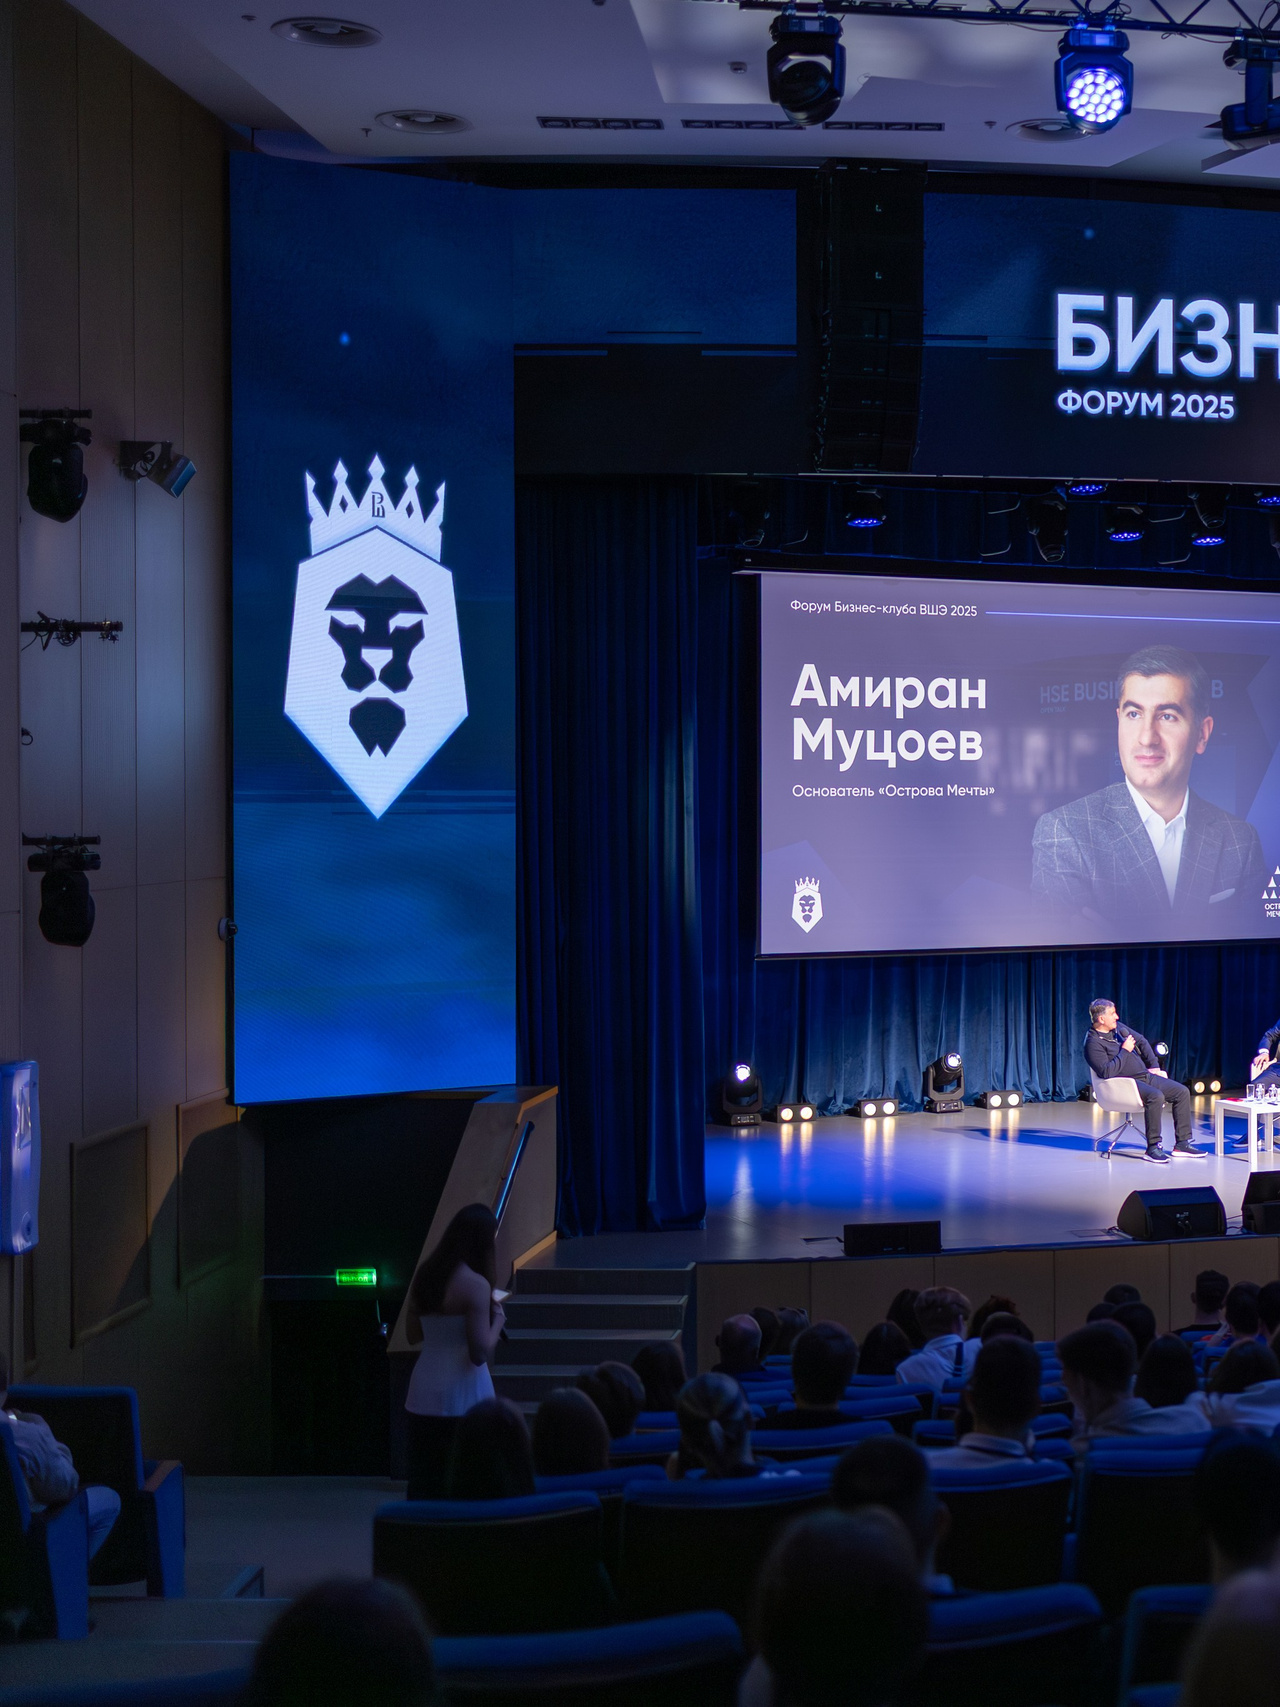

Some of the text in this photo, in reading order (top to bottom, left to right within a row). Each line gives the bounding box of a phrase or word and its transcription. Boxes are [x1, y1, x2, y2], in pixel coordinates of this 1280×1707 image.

[1057, 389, 1235, 420] ФОРУМ 2025
[790, 600, 978, 617] Форум Бизнес-клуба ВШЭ 2025
[790, 663, 986, 719] Амиран
[1040, 684, 1070, 704] HSE
[793, 717, 983, 772] Муцоев
[792, 784, 995, 799] Основатель «Острова Мечты»
